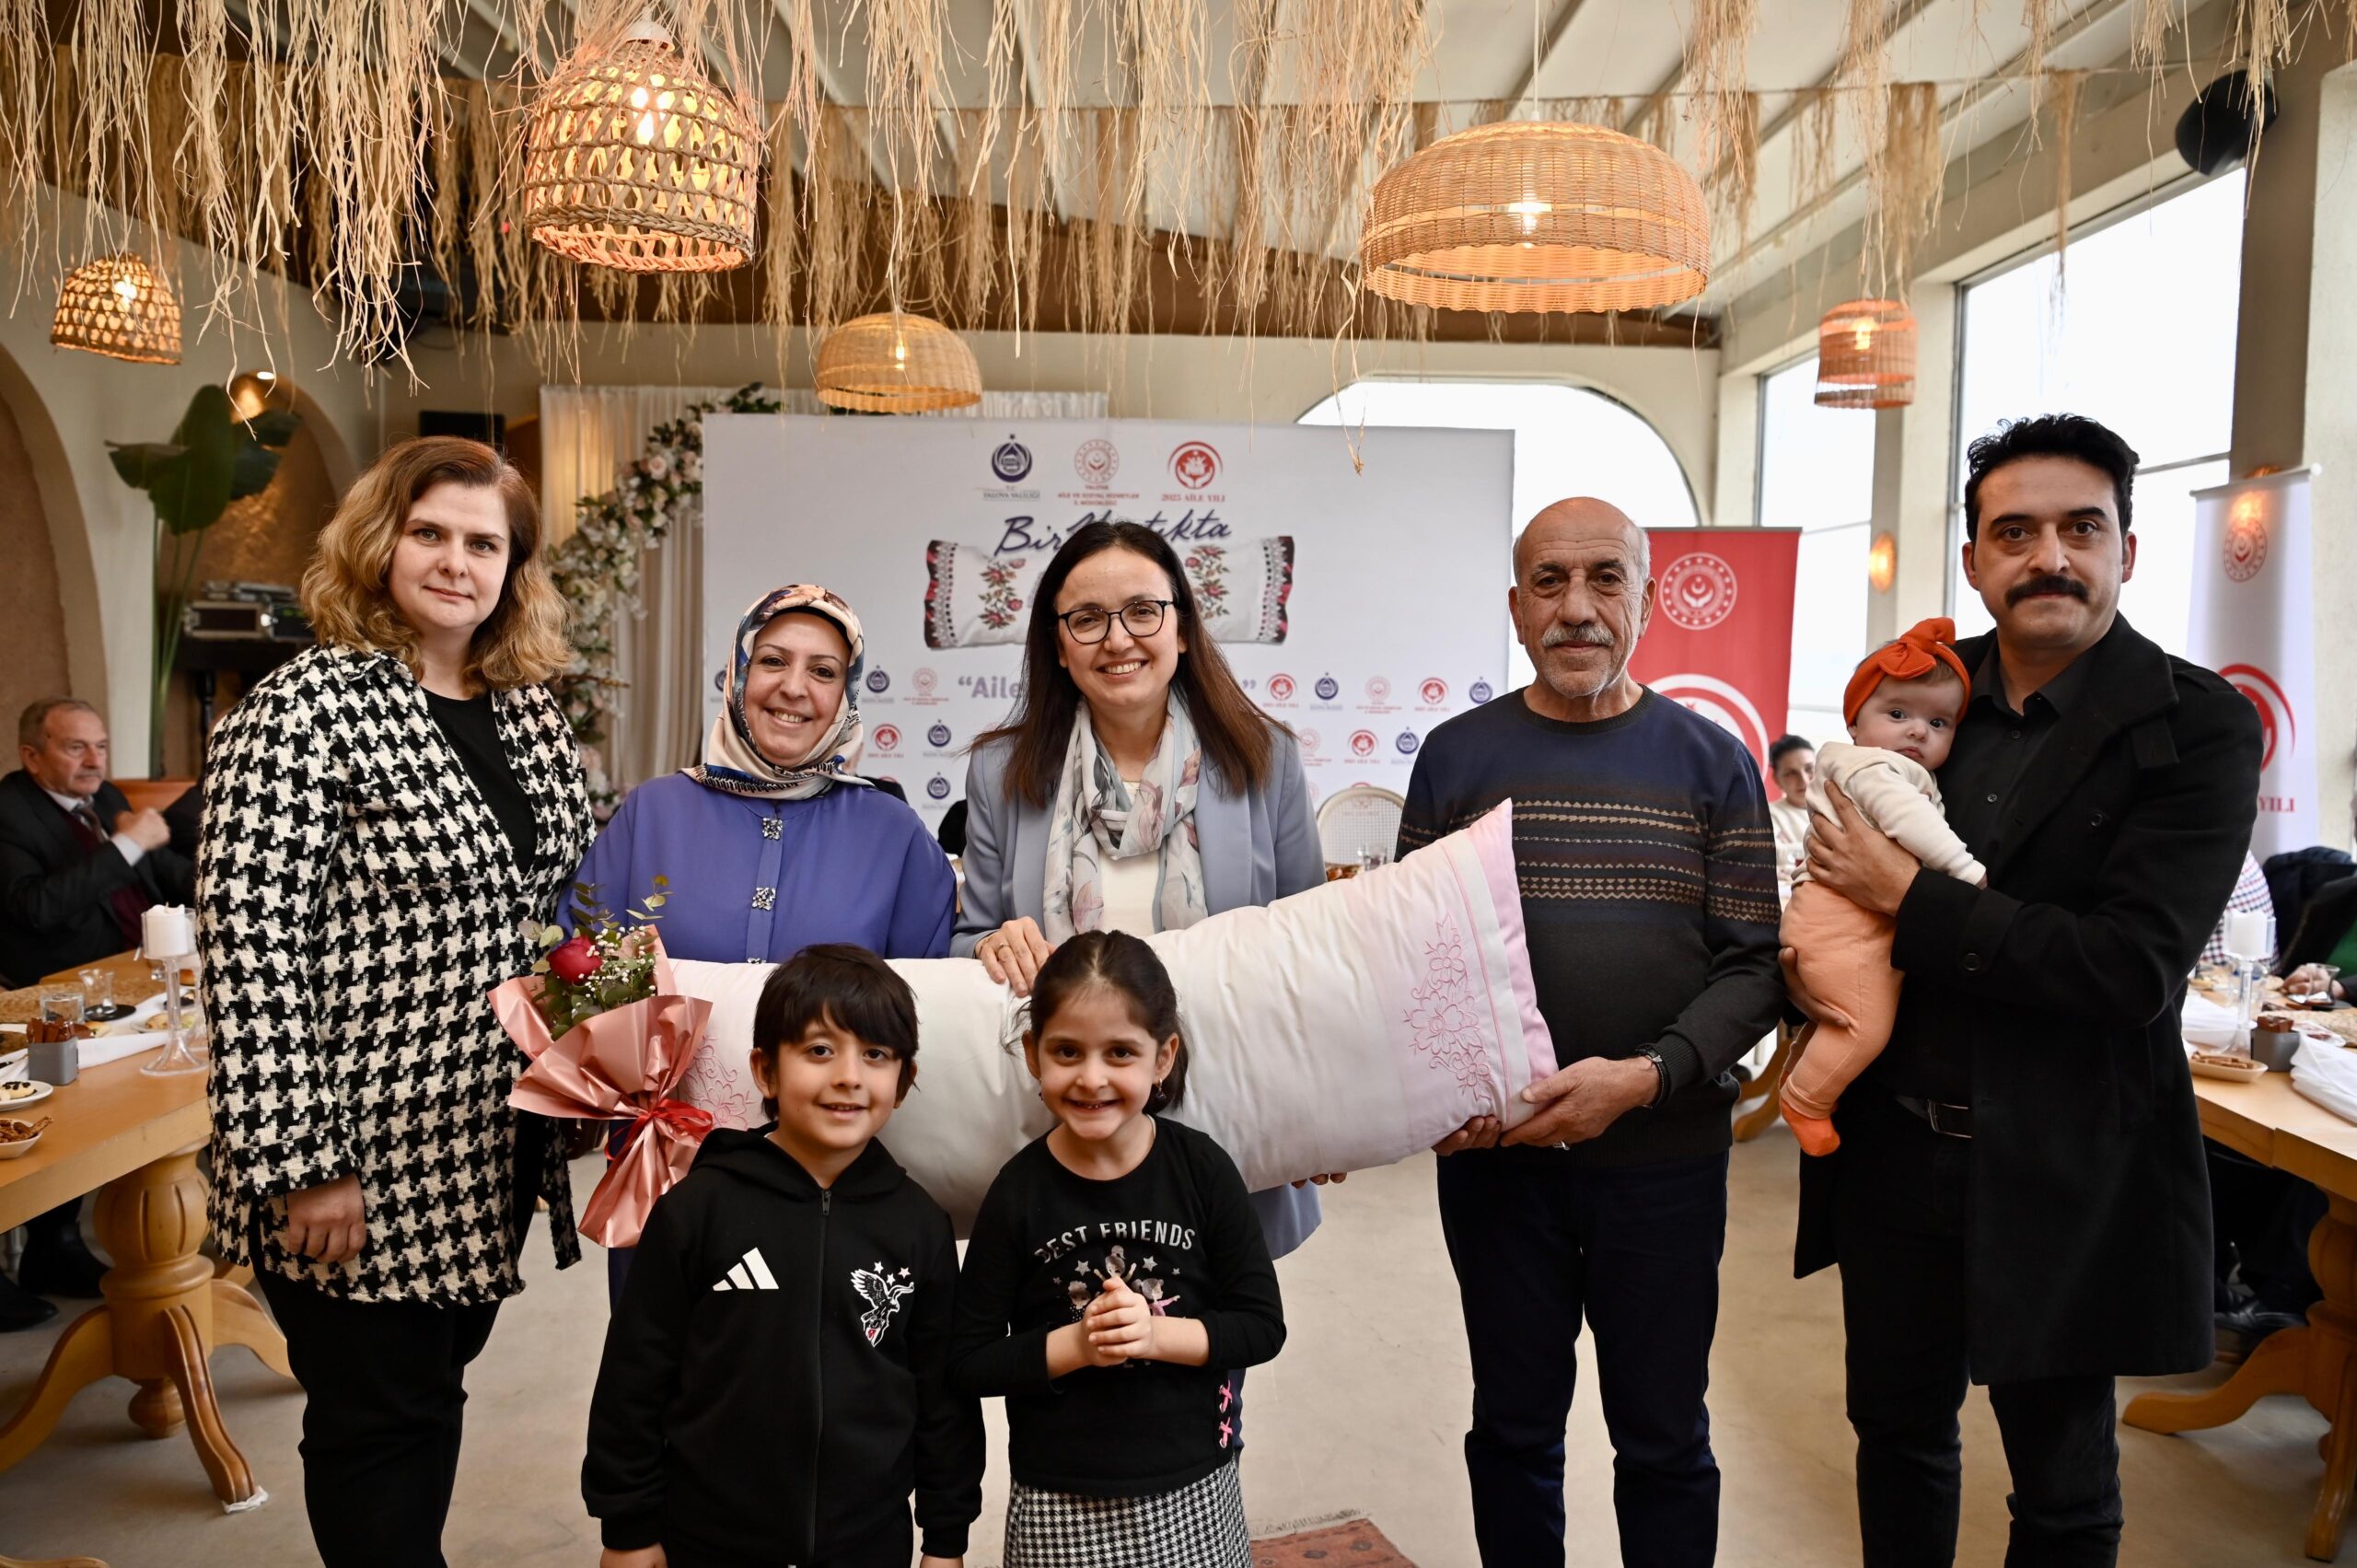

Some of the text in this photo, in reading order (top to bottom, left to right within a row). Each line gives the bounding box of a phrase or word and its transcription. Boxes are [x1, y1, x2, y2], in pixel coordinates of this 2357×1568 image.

[1161, 494, 1181, 502] 2025
[993, 515, 1062, 557] Bir
[1098, 1219, 1196, 1250] FRIENDS
